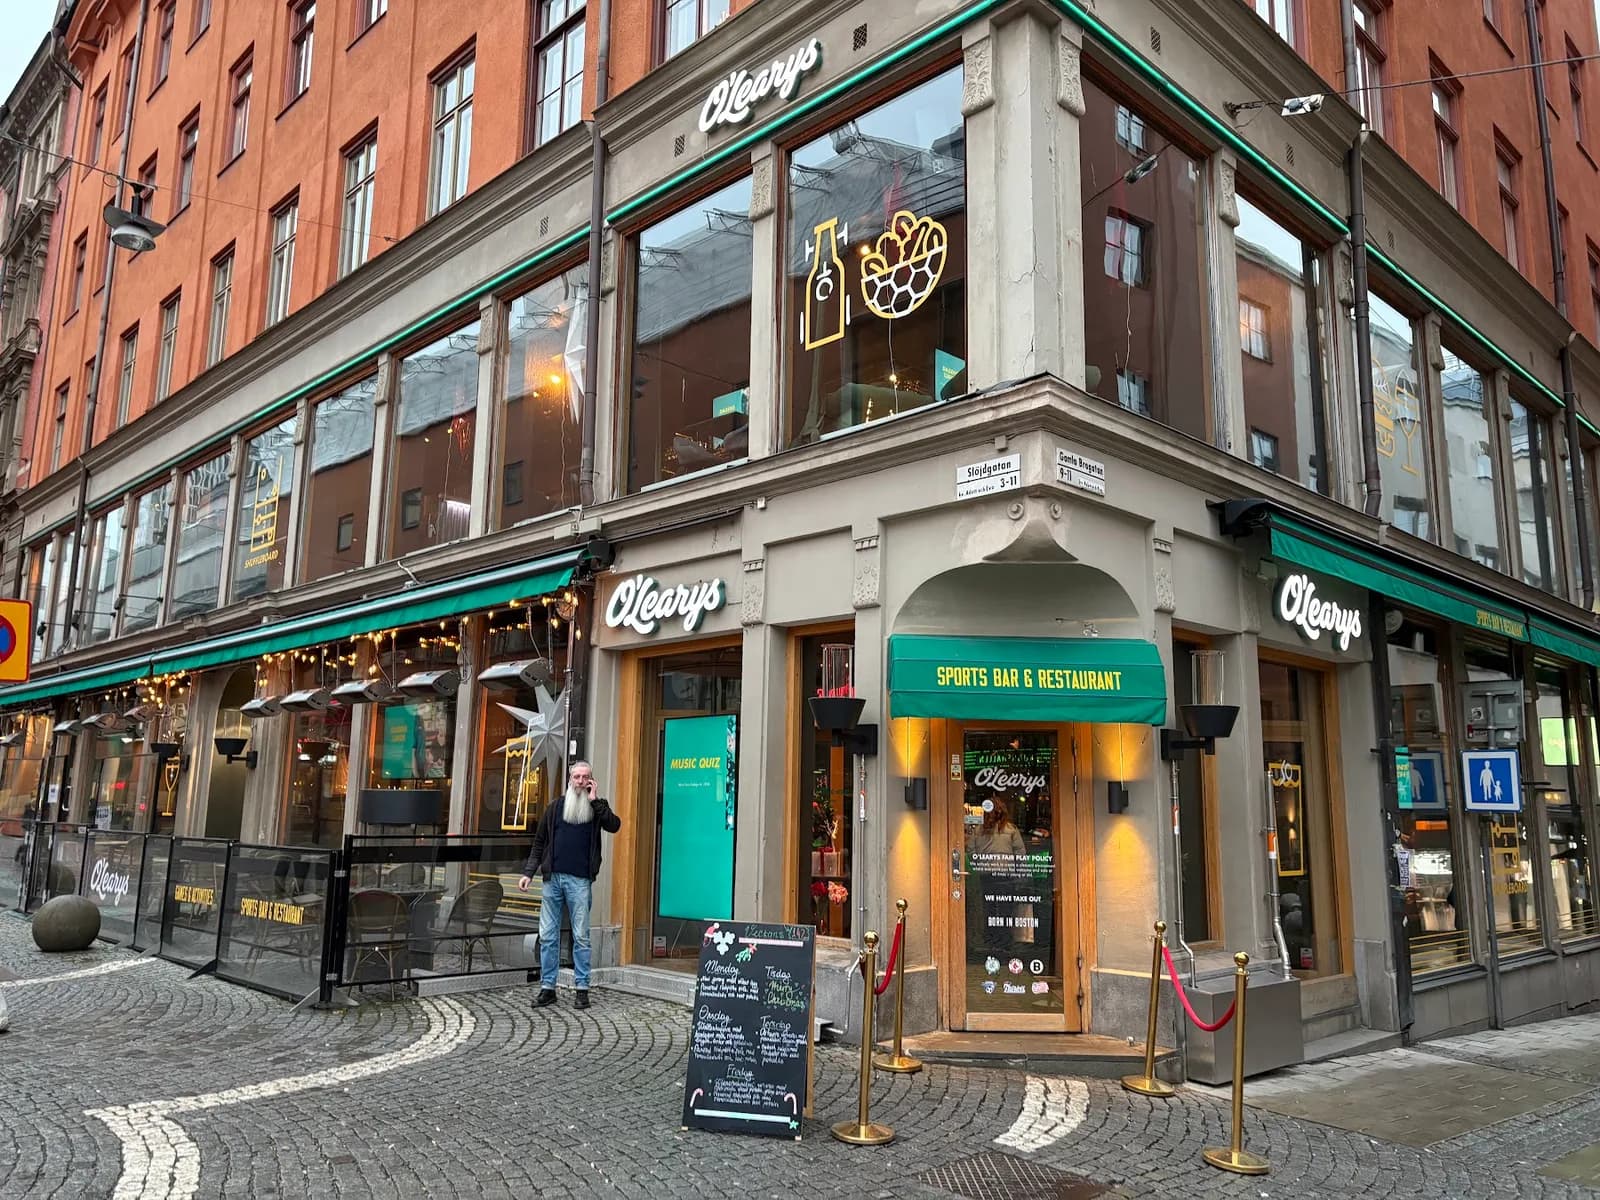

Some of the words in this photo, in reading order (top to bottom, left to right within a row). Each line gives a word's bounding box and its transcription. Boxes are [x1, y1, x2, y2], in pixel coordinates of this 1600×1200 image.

[699, 38, 818, 133] O'Learys
[967, 460, 1012, 477] Slöjdgatan
[1059, 451, 1078, 466] Gamla
[1078, 457, 1104, 476] Brogatan
[1059, 467, 1073, 482] 9-11
[1000, 475, 1017, 489] 3-11
[605, 574, 720, 635] O'Learys
[1280, 574, 1362, 651] O'Learys
[937, 666, 988, 687] SPORTS
[993, 668, 1019, 688] BAR
[1023, 669, 1033, 688] &
[1038, 669, 1122, 691] RESTAURANT
[670, 757, 697, 769] MUSIC
[699, 756, 721, 769] QUIZ
[974, 766, 1046, 794] O'Learys
[91, 858, 130, 906] O'Learys
[984, 894, 995, 902] WE
[241, 897, 259, 918] SPORTS
[273, 902, 305, 925] RESTAURANT
[987, 916, 1005, 927] BORN
[1006, 917, 1013, 927] IN
[1015, 917, 1039, 928] BOSTON
[765, 966, 792, 984] Tisdag
[698, 1004, 731, 1027] Onsdag
